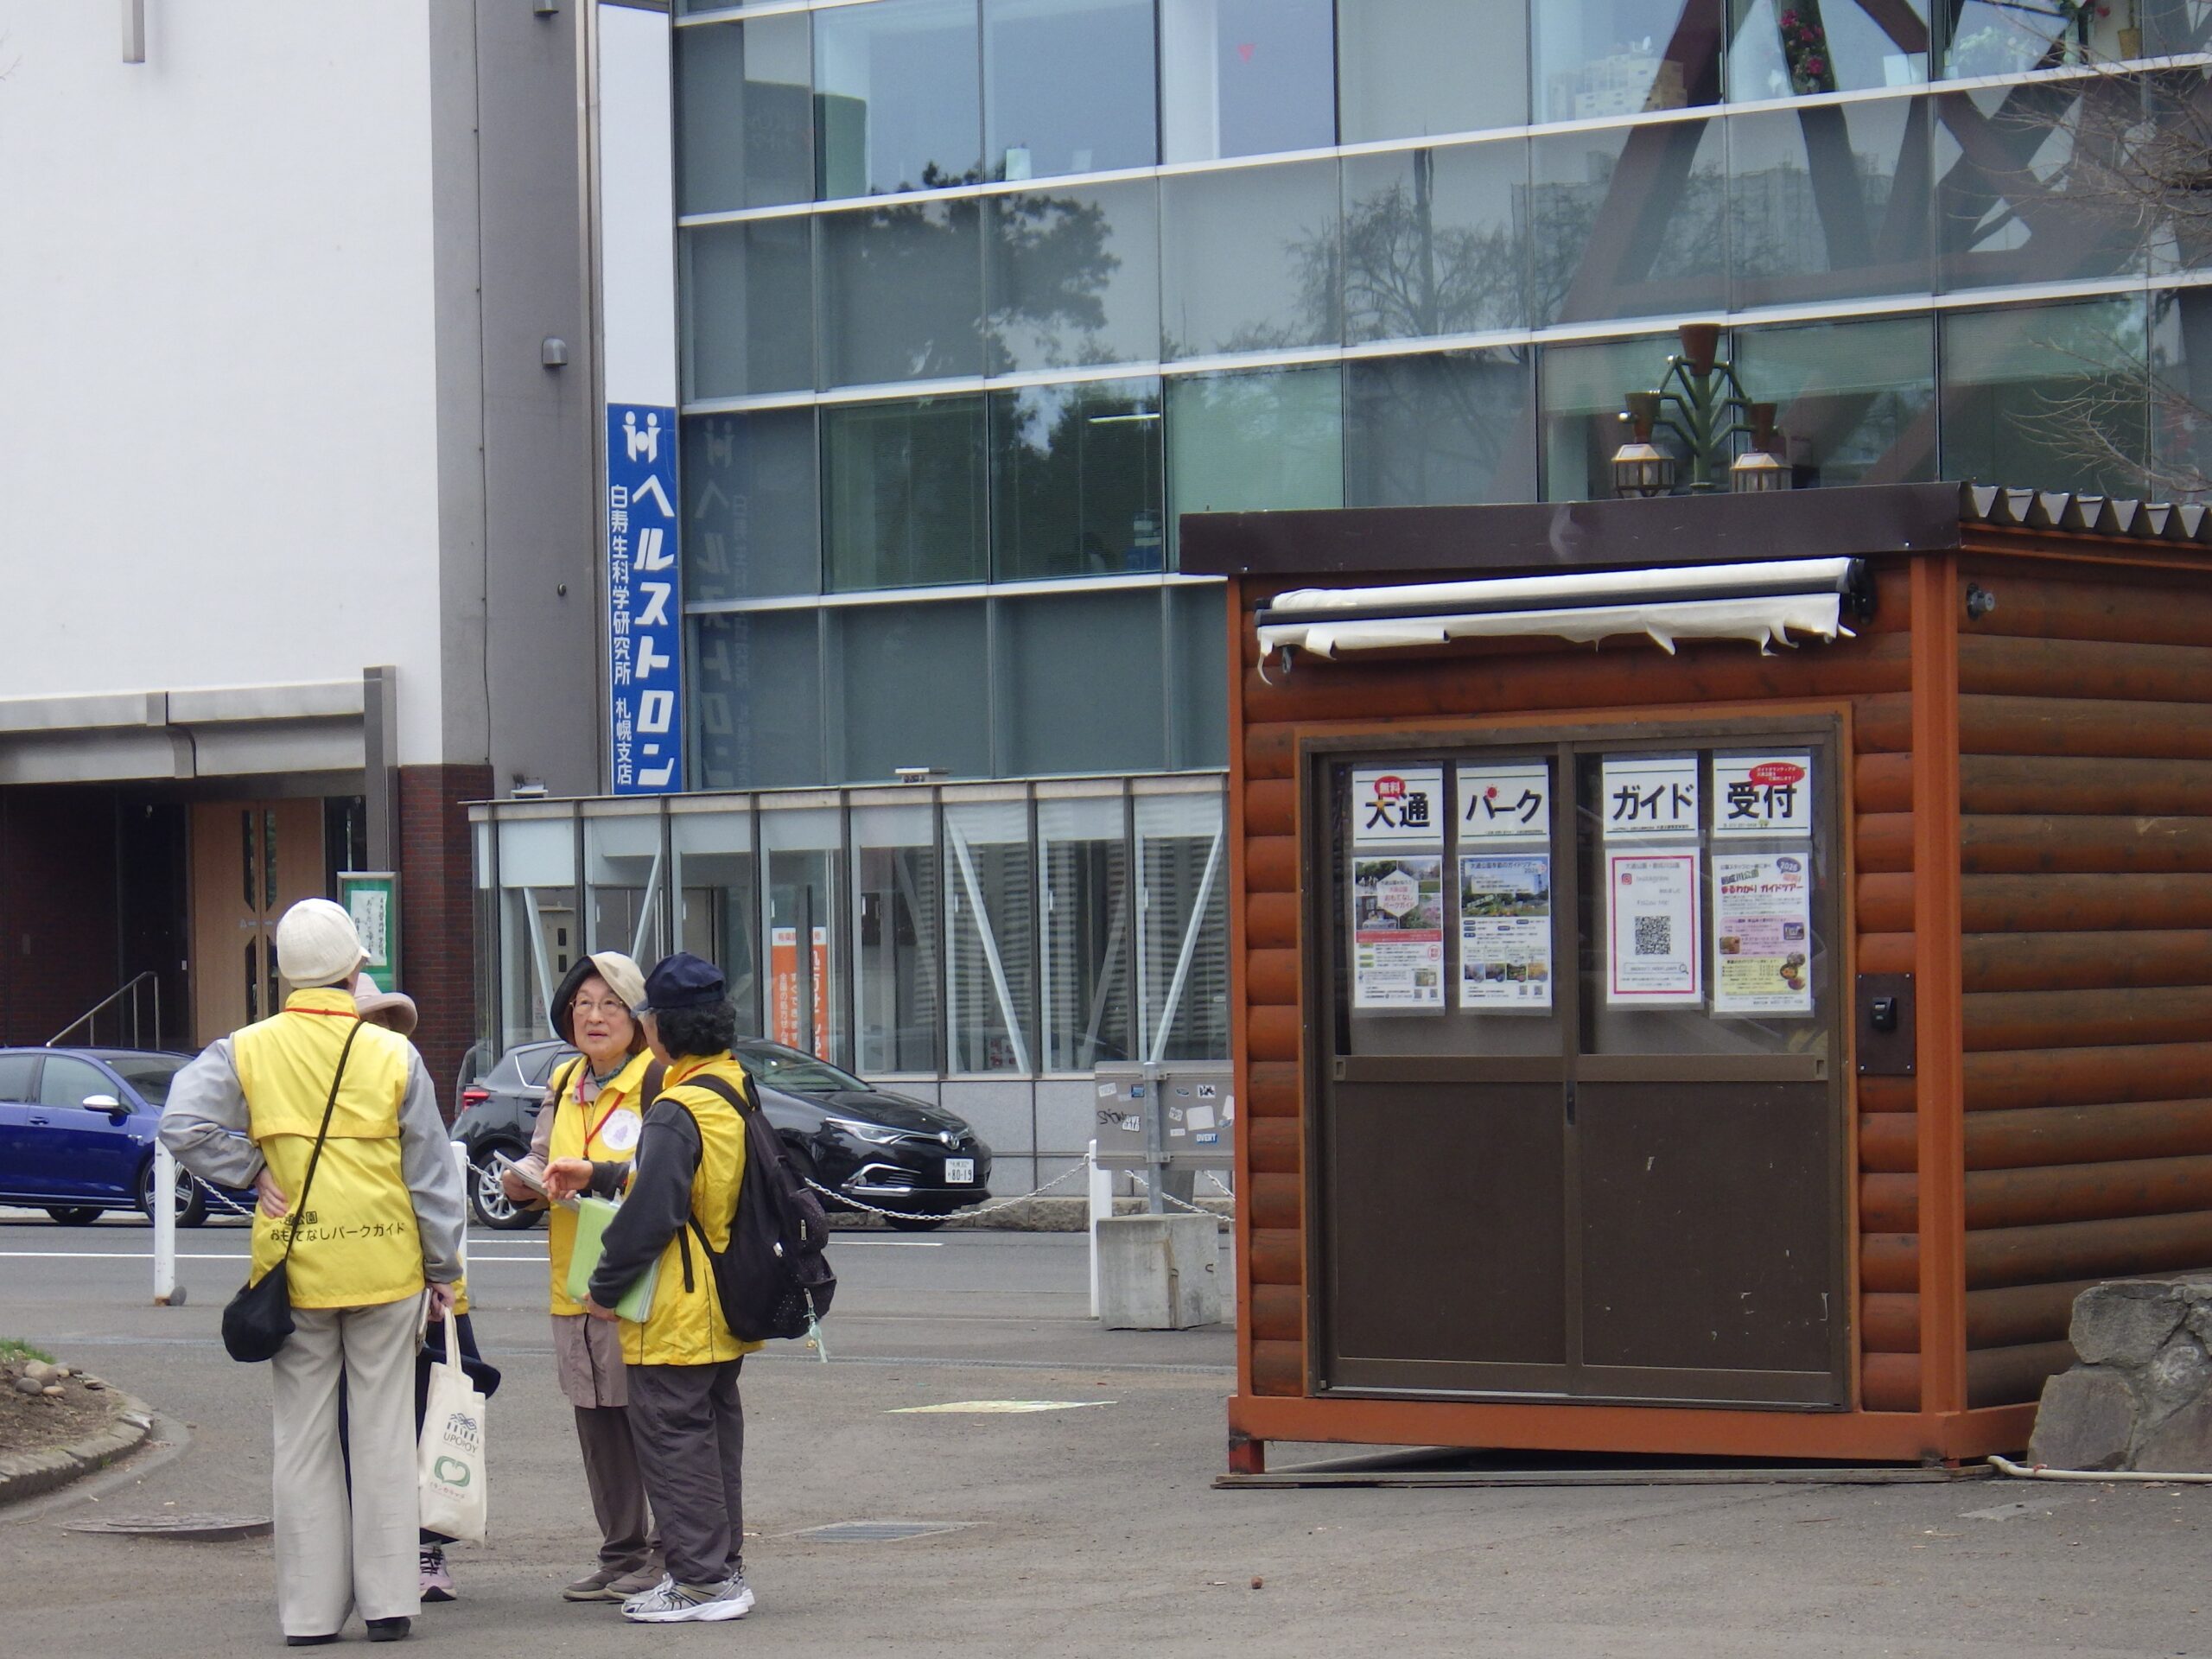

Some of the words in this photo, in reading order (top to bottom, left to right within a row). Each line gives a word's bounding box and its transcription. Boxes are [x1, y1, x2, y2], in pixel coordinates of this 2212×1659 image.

[610, 484, 630, 685] 白寿生科学研究所
[632, 474, 675, 786] ヘルストロン
[615, 696, 632, 785] 札幌支店
[1365, 792, 1430, 830] 大通
[1466, 785, 1541, 823] パーク
[1612, 783, 1694, 821] ガイド
[1728, 780, 1797, 820] 受付
[270, 1222, 407, 1243] おもてなしパークガイド
